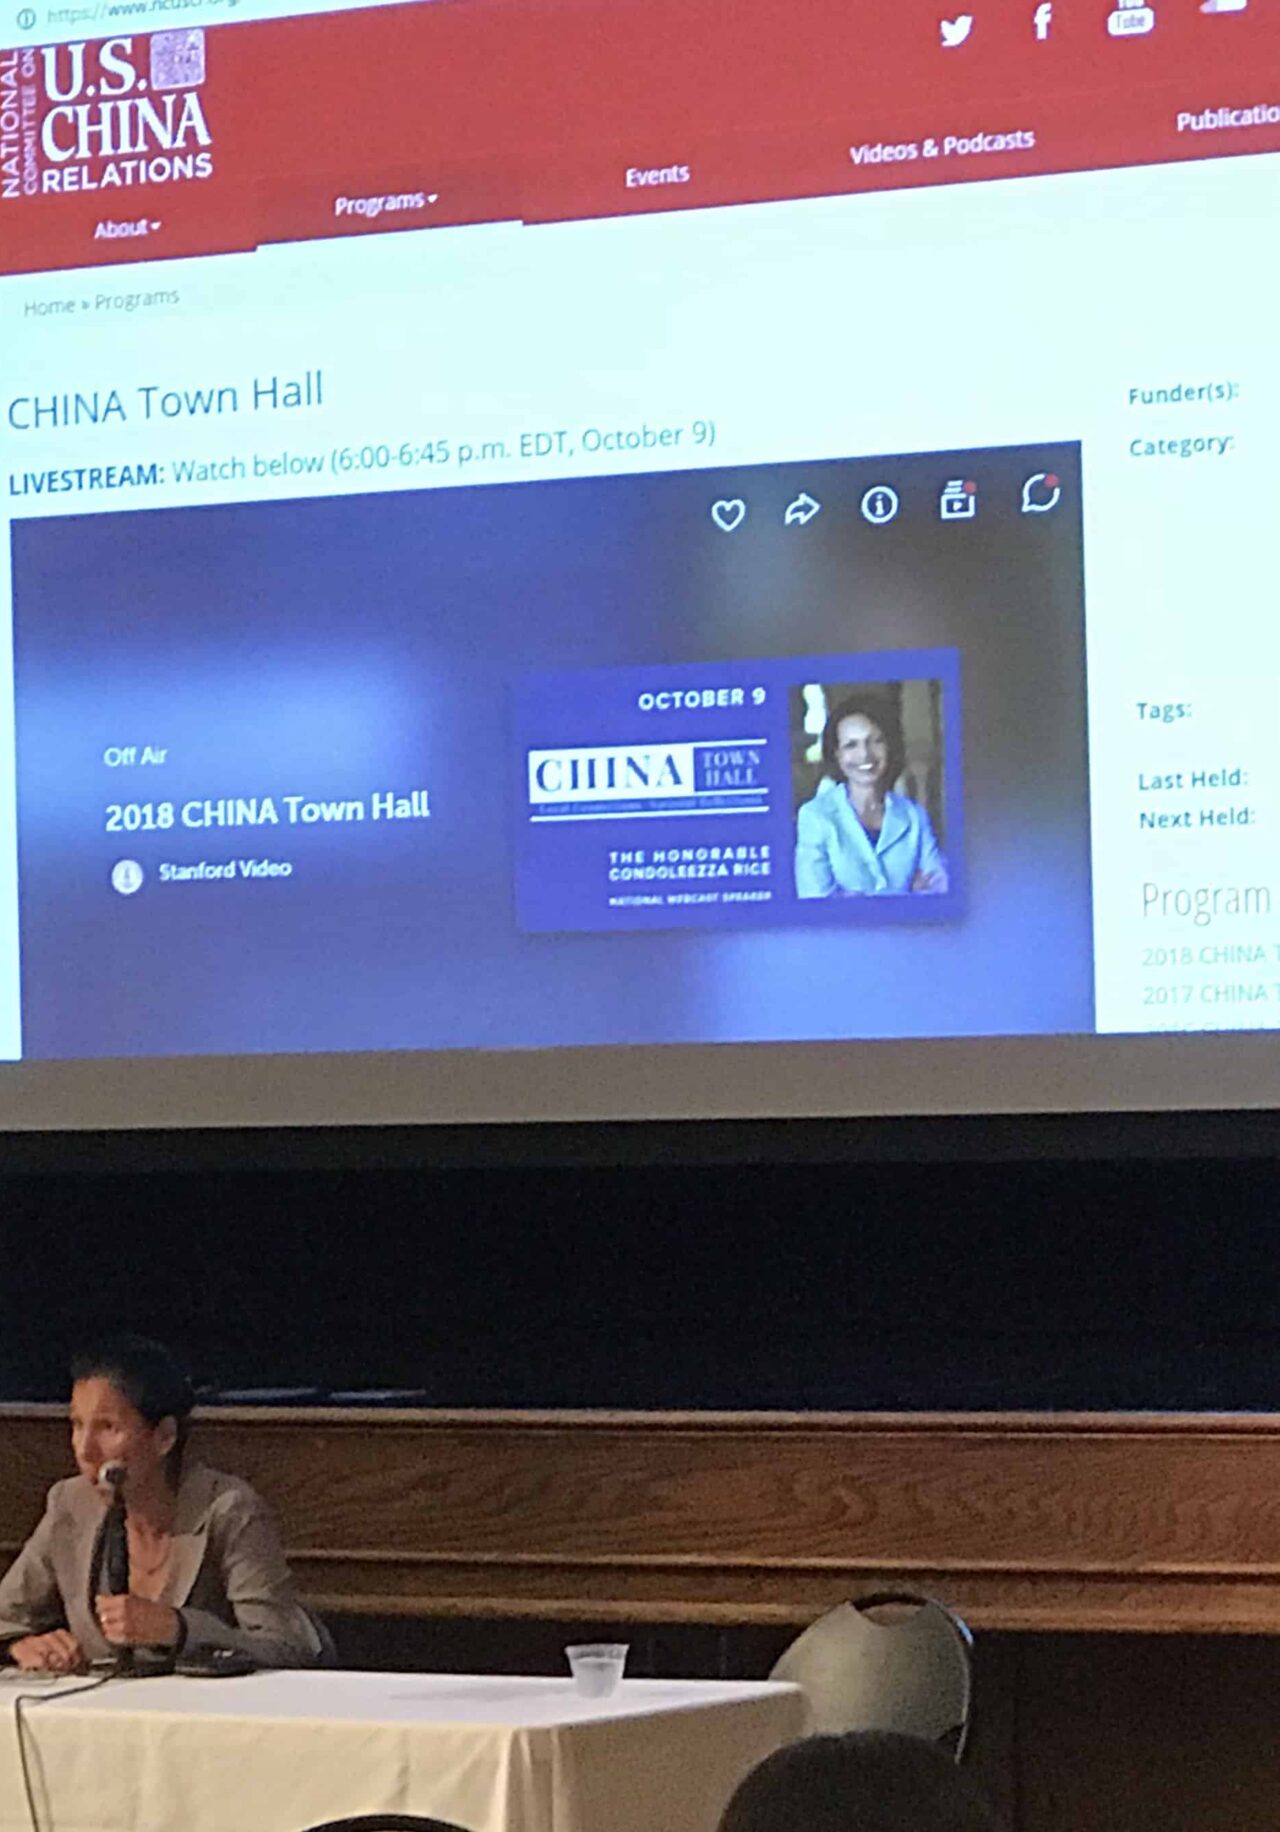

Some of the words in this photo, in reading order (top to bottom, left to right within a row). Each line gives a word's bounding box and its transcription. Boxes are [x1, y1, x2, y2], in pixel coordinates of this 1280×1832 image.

[21, 48, 37, 78] ON
[41, 38, 148, 102] U.S.
[0, 51, 20, 198] NATIONAL
[41, 91, 212, 163] CHINA
[22, 85, 38, 195] COMMITTEE
[849, 141, 918, 165] Videos
[922, 138, 939, 158] &
[943, 130, 1036, 155] Podcasts
[42, 153, 213, 194] RELATIONS
[626, 165, 690, 188] Events
[335, 192, 425, 218] Programs
[94, 220, 148, 240] About
[24, 297, 76, 318] Home
[95, 289, 180, 314] Programs
[8, 390, 127, 430] CHINA
[138, 386, 238, 419] Town
[253, 369, 323, 411] Hall
[1128, 380, 1239, 405] Funder(s):
[9, 463, 164, 496] LIVESTREAM:
[171, 459, 246, 483] Watch
[253, 451, 325, 478] below
[331, 440, 450, 475] (6:00-6:45
[458, 444, 512, 468] p.m.
[520, 430, 574, 458] EDT,
[582, 424, 683, 453] October
[692, 420, 716, 447] 9)
[1130, 435, 1235, 458] Category:
[638, 687, 745, 711] OCTOBER
[752, 686, 767, 705] 9
[1136, 701, 1192, 723] Tags:
[103, 747, 136, 767] Off
[140, 746, 168, 766] Air
[535, 753, 683, 793] CHINA
[701, 749, 761, 769] TOWN
[705, 768, 758, 787] HALL
[1138, 772, 1184, 791] Last
[1191, 769, 1248, 788] Held:
[105, 803, 175, 832] 2018
[181, 797, 279, 828] CHINA
[283, 796, 365, 824] Town
[372, 790, 431, 820] Hall
[1140, 811, 1192, 829] Next
[1200, 807, 1255, 826] Held:
[609, 850, 645, 865] THE
[653, 845, 770, 862] HONORABLE
[159, 861, 236, 882] Stanford
[239, 859, 293, 878] Video
[609, 863, 729, 882] CONDOLEEZZA
[733, 861, 771, 876] RICE
[1142, 882, 1271, 927] Program
[1142, 946, 1194, 967] 2018
[1199, 944, 1266, 965] CHINA
[1143, 984, 1195, 1006] 2017
[1200, 983, 1268, 1004] CHINA
